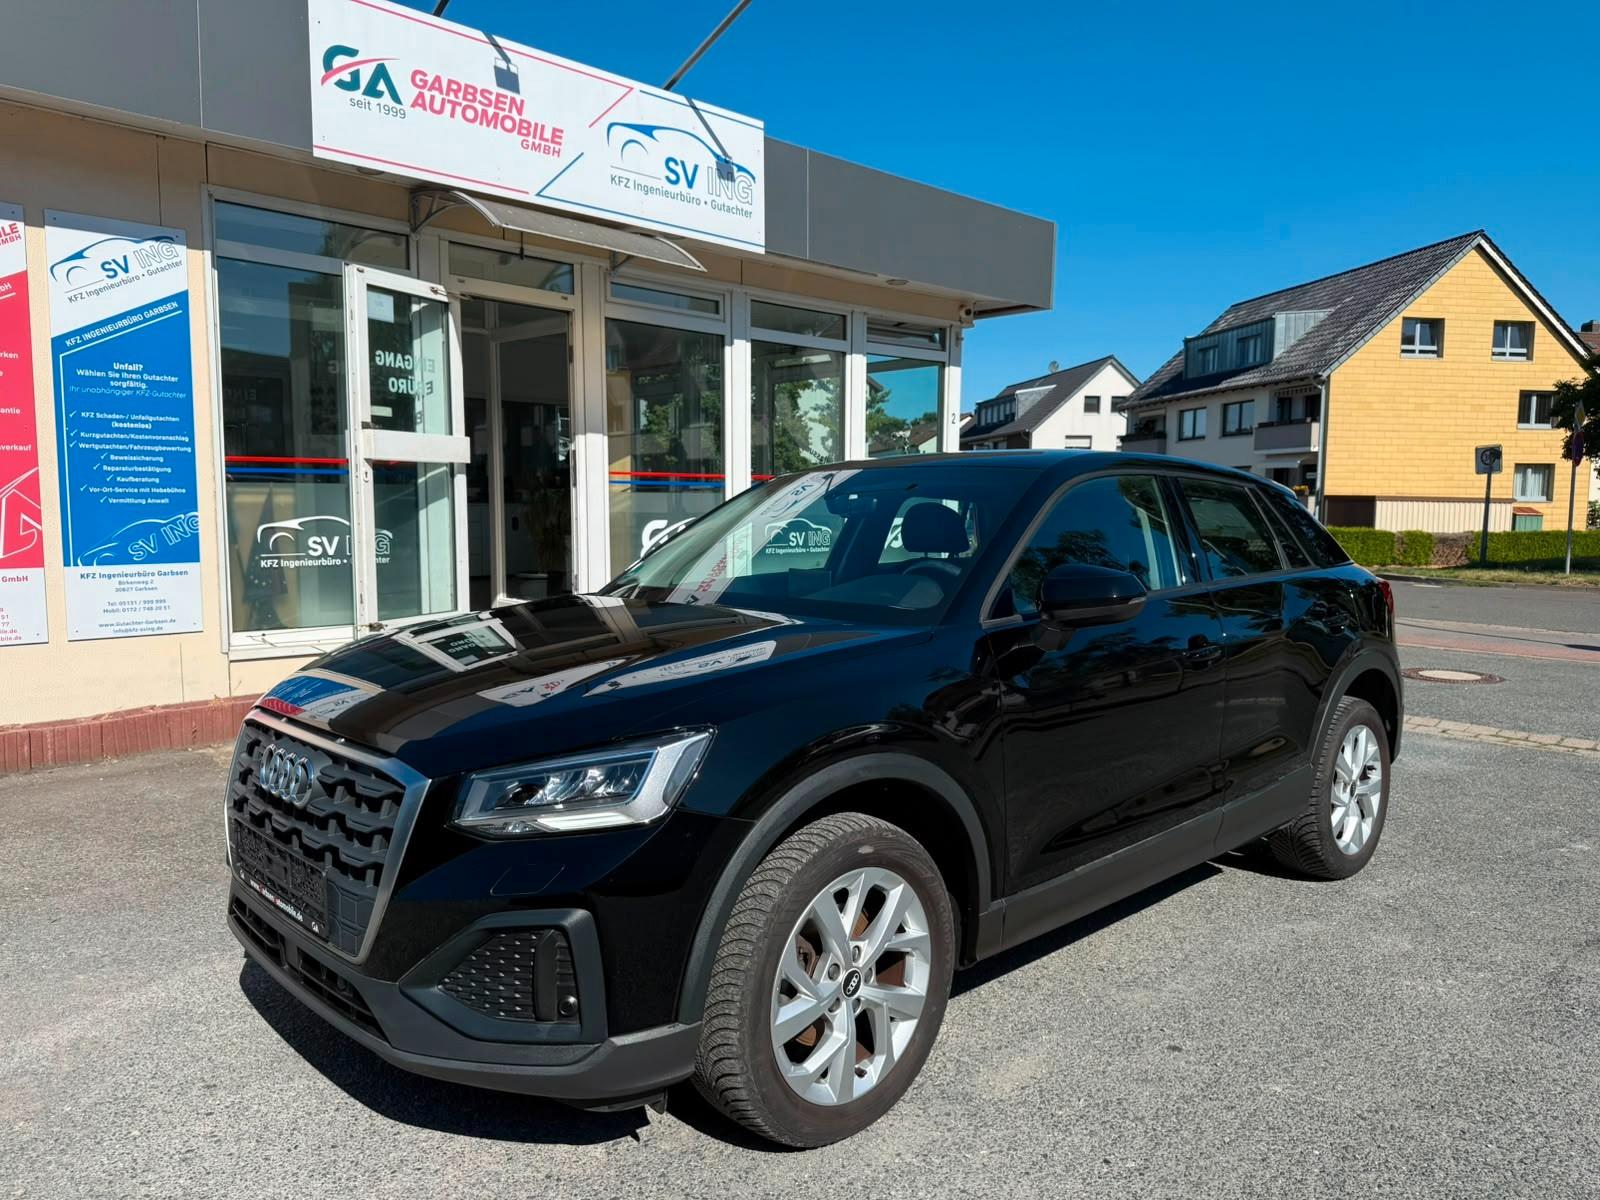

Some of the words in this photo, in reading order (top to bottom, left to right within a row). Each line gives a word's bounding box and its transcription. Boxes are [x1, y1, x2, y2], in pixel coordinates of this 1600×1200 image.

[322, 44, 403, 106] GA
[410, 69, 525, 116] GARBSEN
[349, 97, 372, 112] seit
[376, 103, 406, 119] 1999
[410, 91, 564, 145] AUTOMOBILE
[520, 139, 561, 158] GMBH
[664, 156, 699, 189] SV
[706, 166, 753, 206] ING
[610, 174, 631, 189] KFZ
[633, 180, 701, 206] Ingenieurbüro
[710, 200, 753, 219] Gutachter
[100, 254, 130, 280] SV
[133, 241, 180, 269] ING
[67, 292, 86, 304] KFZ
[85, 274, 141, 298] Ingenieurbüro
[146, 259, 183, 277] Gutachter
[65, 336, 82, 347] KFZ
[81, 314, 144, 342] INGENIEURBÜRO
[143, 301, 178, 319] GARBSEN
[76, 368, 106, 378] Wählen
[108, 370, 120, 378] Sie
[121, 371, 141, 380] Ihren
[143, 373, 179, 382] Gutachter
[113, 362, 143, 371] Unfall?
[110, 380, 148, 389] sorgfältig.
[111, 421, 152, 429] (kostenlos)
[127, 533, 158, 561] SV
[307, 535, 340, 556] SV
[789, 531, 805, 546] SV
[808, 530, 831, 546] ING
[260, 559, 279, 568] KFZ
[280, 557, 341, 569] Ingenieurbüro
[80, 572, 97, 580] KFZ
[98, 570, 156, 580] Ingenieurbüro
[157, 569, 189, 577] Garbsen
